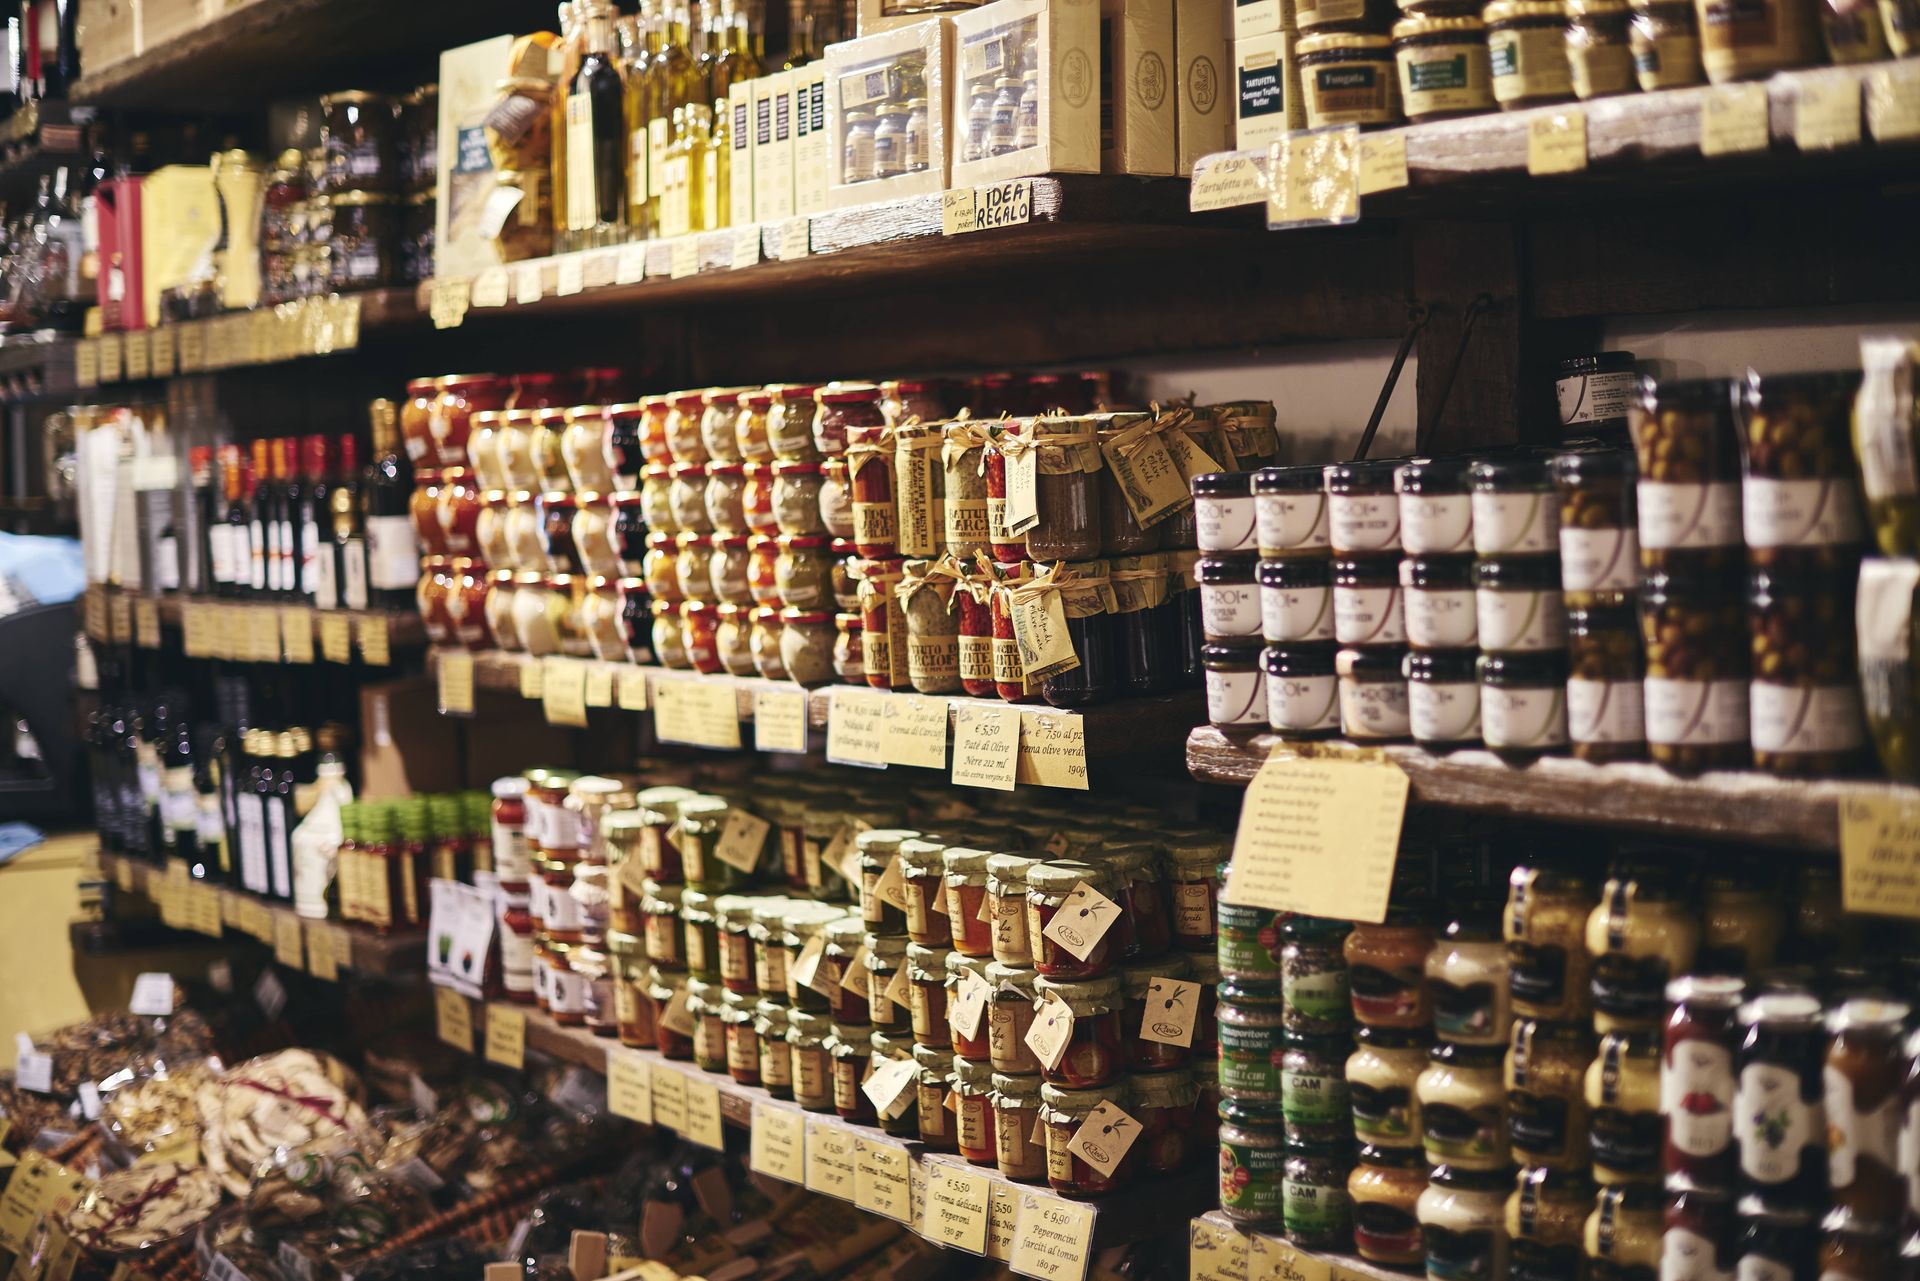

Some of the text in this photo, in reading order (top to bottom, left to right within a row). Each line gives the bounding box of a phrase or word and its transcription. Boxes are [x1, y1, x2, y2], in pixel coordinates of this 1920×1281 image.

[1246, 76, 1276, 88] TARTUFETTA
[1243, 90, 1262, 101] Summer
[1253, 98, 1270, 107] Butter
[1199, 178, 1242, 195] Tartufetta
[986, 183, 1024, 208] IDEA
[976, 203, 1028, 228] REGALO
[1215, 591, 1240, 605] ROI
[981, 725, 1000, 736] 5,50
[1046, 729, 1062, 740] 7,50
[1063, 727, 1071, 739] al
[981, 739, 990, 751] di
[990, 740, 1010, 753] Olive
[1020, 743, 1085, 757] rema olive verdi
[1068, 764, 1086, 777] 190g
[858, 1162, 878, 1176] Crema
[947, 1178, 970, 1193] € 5,50
[933, 1191, 955, 1206] Crema
[955, 1197, 983, 1214] delicata
[995, 1201, 1012, 1214] 5,50
[940, 1208, 970, 1225] Peperoni
[1043, 1210, 1071, 1225] € 9,90
[943, 1226, 964, 1238] 130 gr
[1002, 1220, 1016, 1232] Noc
[1001, 1236, 1012, 1246] gr
[1032, 1223, 1078, 1246] Peperoncini
[1021, 1235, 1079, 1263] farciti al tonno
[1036, 1258, 1060, 1273] 180 gr
